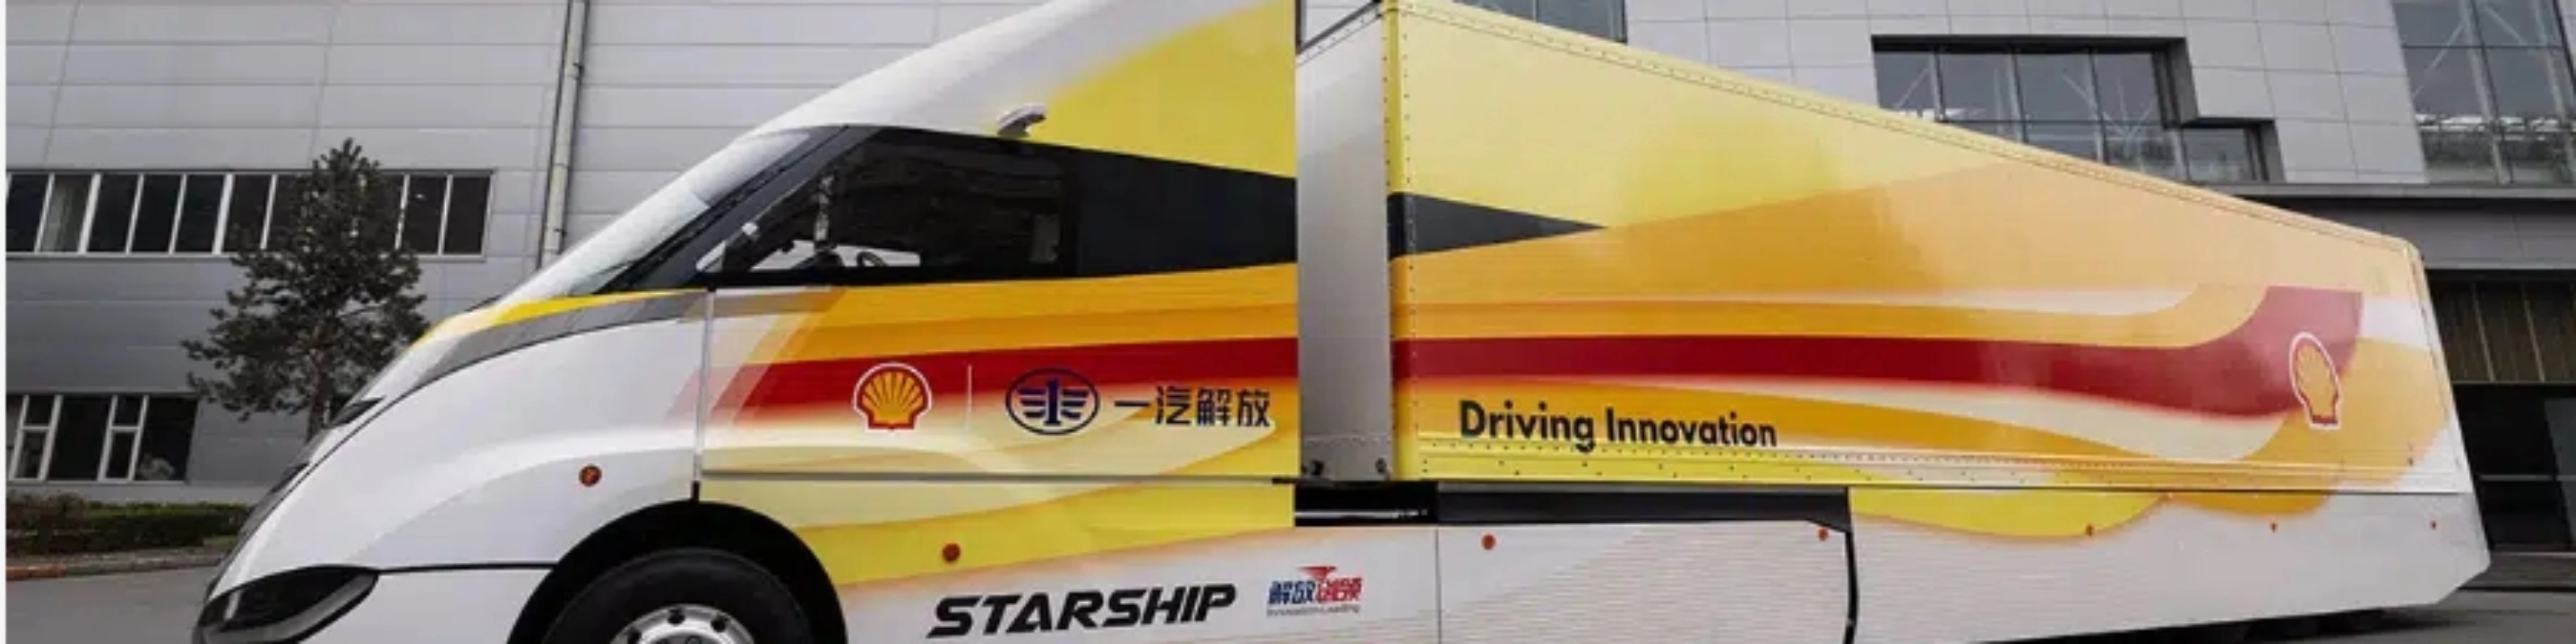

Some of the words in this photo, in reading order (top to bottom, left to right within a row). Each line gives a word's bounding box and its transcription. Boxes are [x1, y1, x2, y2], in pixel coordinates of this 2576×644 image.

[1114, 385, 1271, 427] 一汽解放
[1459, 399, 1596, 452] Driving
[1605, 407, 1777, 448] Innovation
[927, 583, 1236, 638] STARSHIP
